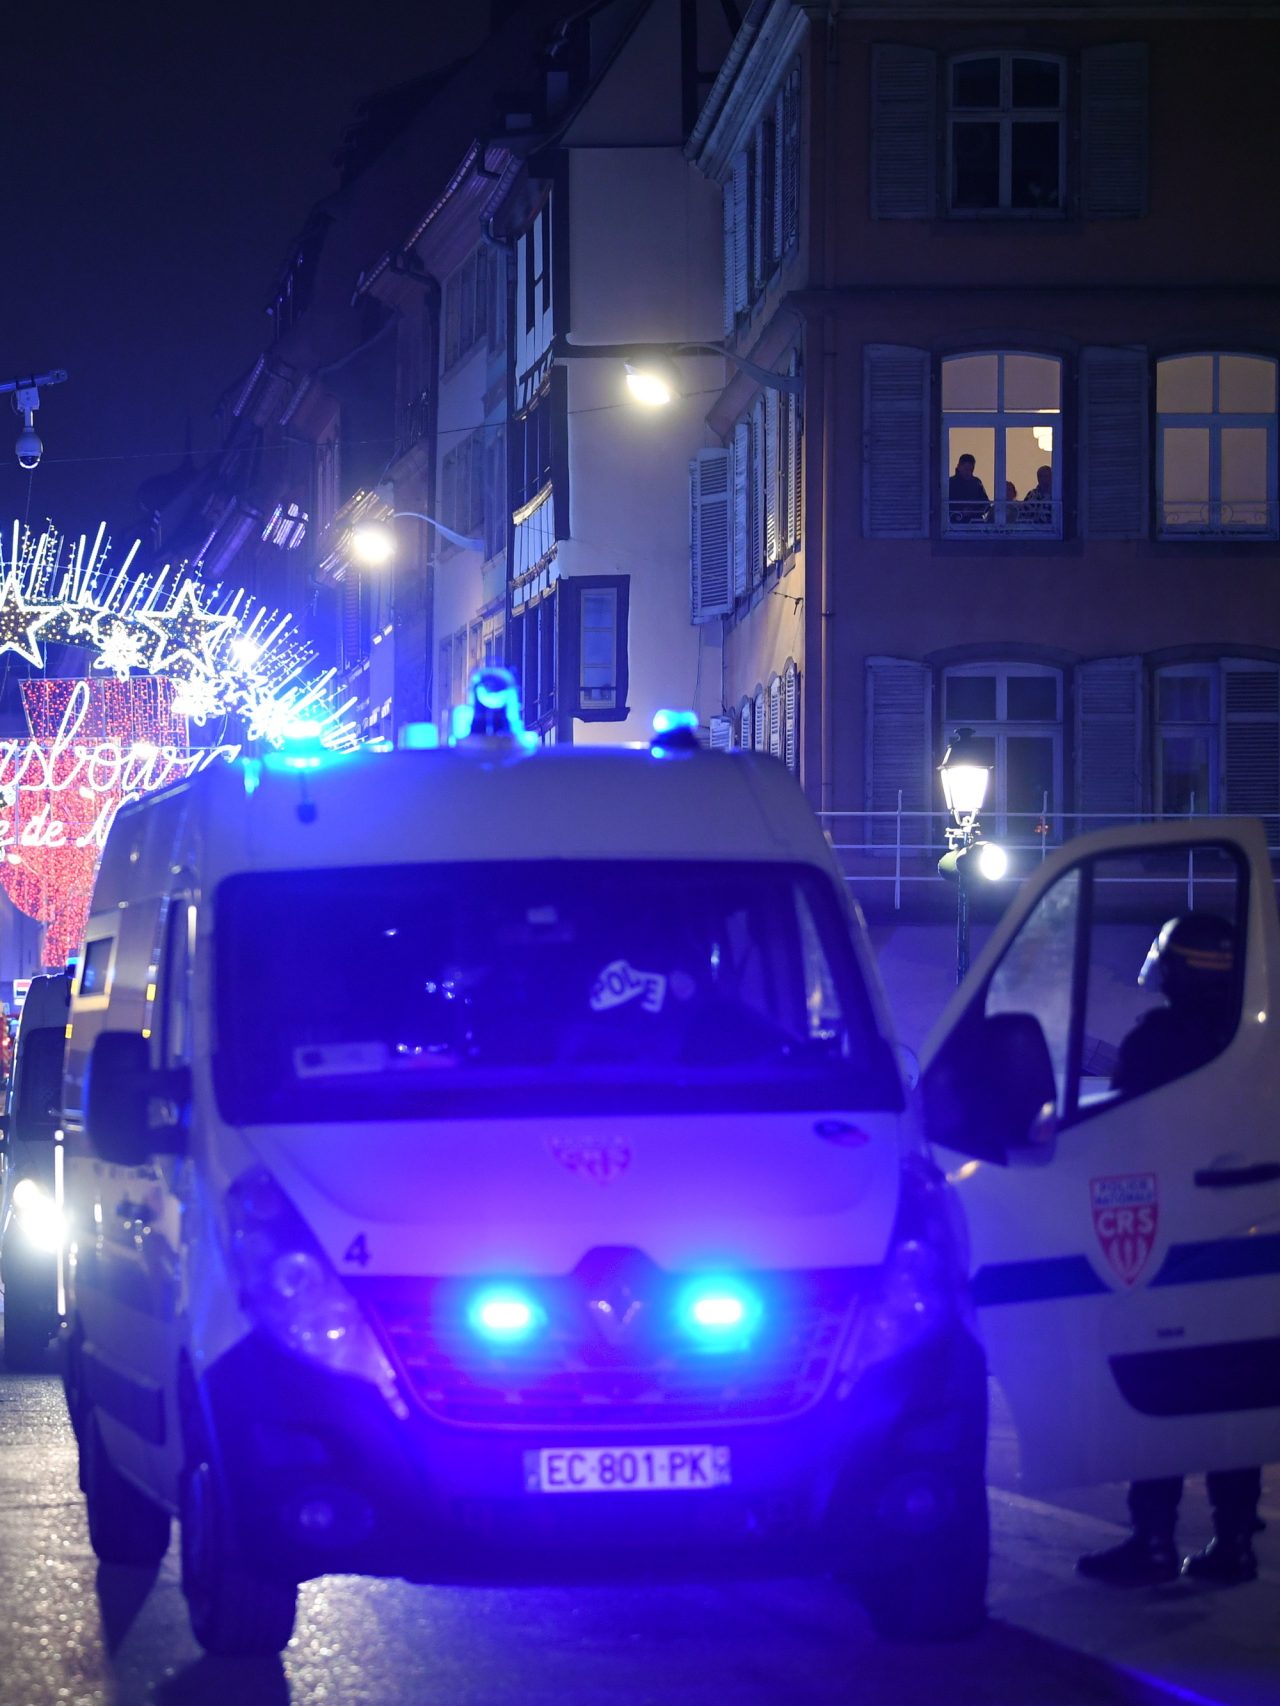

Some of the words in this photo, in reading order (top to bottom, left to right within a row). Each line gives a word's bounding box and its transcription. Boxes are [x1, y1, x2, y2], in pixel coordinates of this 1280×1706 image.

[20, 801, 66, 847] de
[1098, 1207, 1155, 1237] CRS
[344, 1233, 370, 1267] 4
